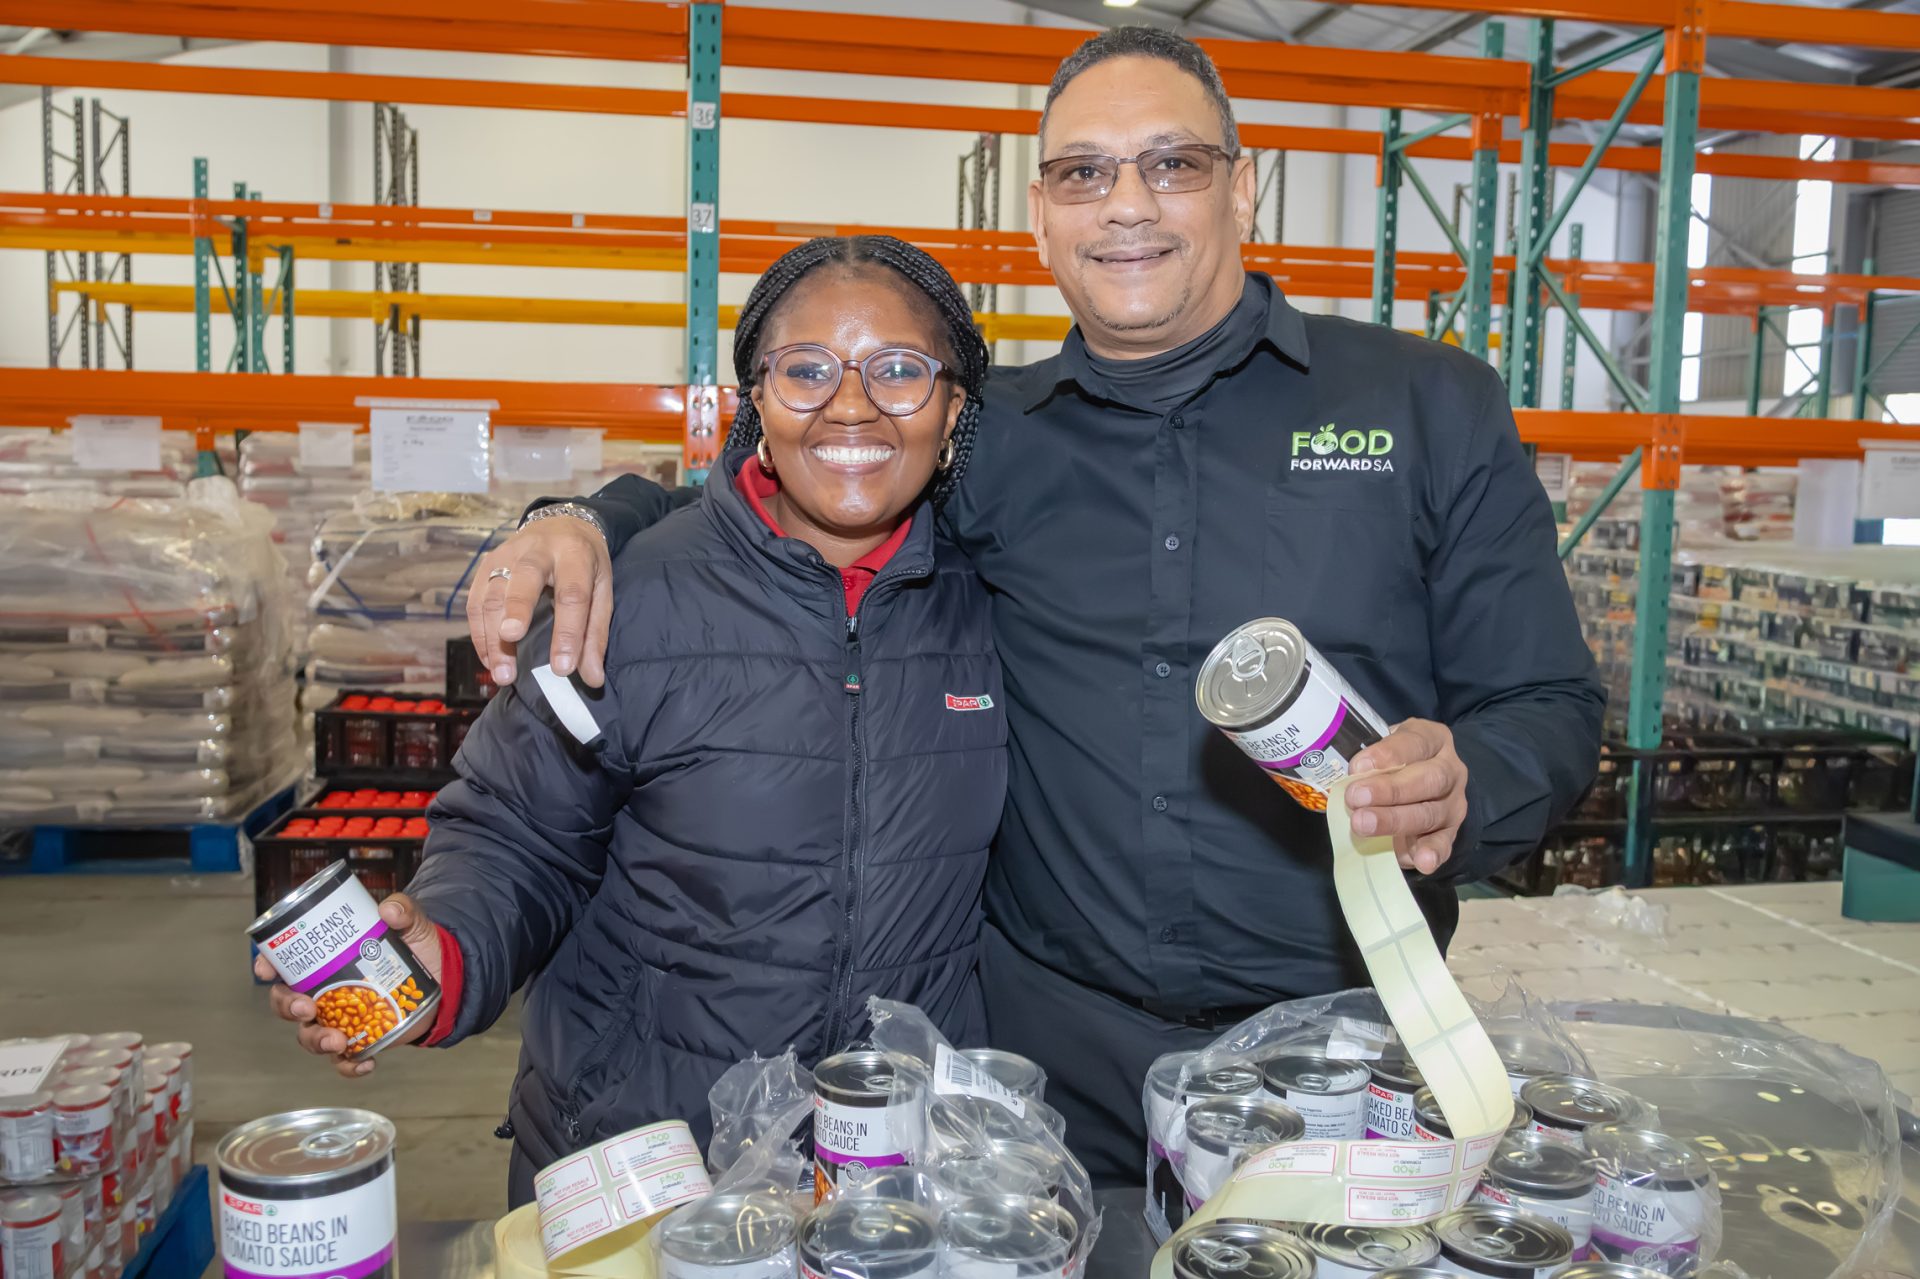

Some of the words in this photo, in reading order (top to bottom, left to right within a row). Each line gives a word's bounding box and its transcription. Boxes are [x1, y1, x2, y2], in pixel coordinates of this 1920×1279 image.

[696, 108, 714, 124] 36
[693, 209, 712, 225] 37
[1292, 428, 1394, 456] FOOD
[1247, 733, 1287, 751] BEANS
[1284, 724, 1300, 738] IN
[1263, 738, 1303, 759] SAUCE
[273, 928, 298, 946] SPAR
[275, 938, 309, 965] BAKED
[306, 912, 344, 945] BEANS
[339, 903, 355, 919] IN
[285, 946, 326, 977] TOMATO
[322, 920, 360, 952] SAUCE
[1370, 1086, 1393, 1100] SPAR
[824, 1114, 854, 1136] BEANS
[856, 1122, 868, 1137] IN
[828, 1132, 860, 1151] SAUCE
[229, 1197, 262, 1213] SPAR
[1608, 1194, 1648, 1220] BEANS
[1652, 1207, 1665, 1222] IN
[267, 1220, 326, 1244] BEANS
[331, 1215, 348, 1238] IN
[1614, 1214, 1655, 1238] SAUCE
[280, 1241, 338, 1267] SAUCE
